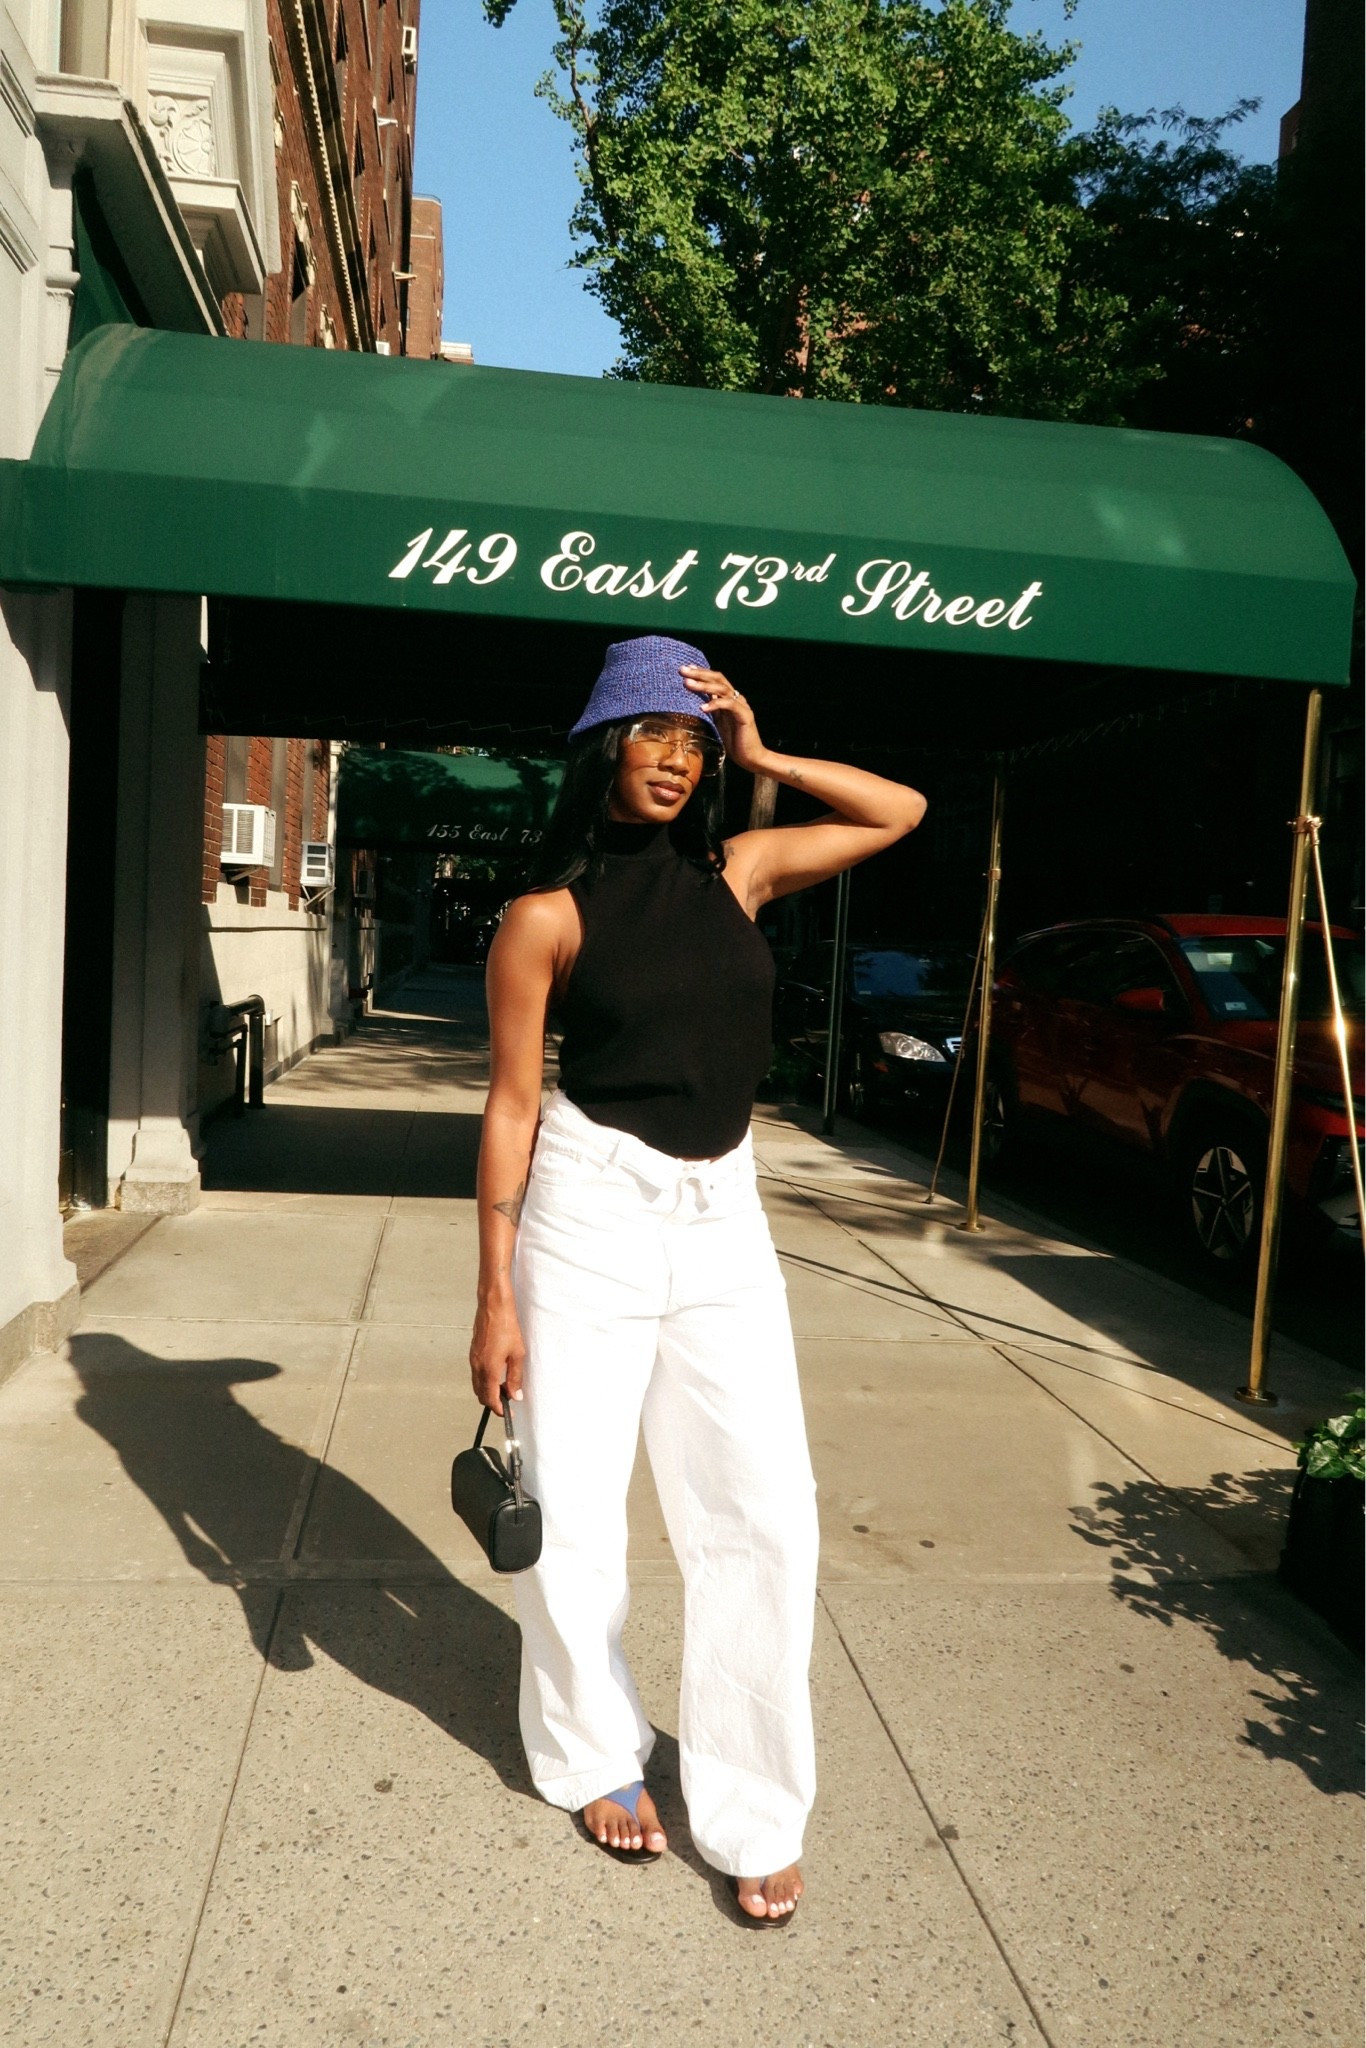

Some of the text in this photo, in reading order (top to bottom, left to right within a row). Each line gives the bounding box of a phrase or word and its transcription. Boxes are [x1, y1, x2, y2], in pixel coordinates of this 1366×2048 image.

[387, 527, 1043, 631] 149 East 73rd Street
[426, 824, 462, 839] 155
[468, 823, 510, 842] East
